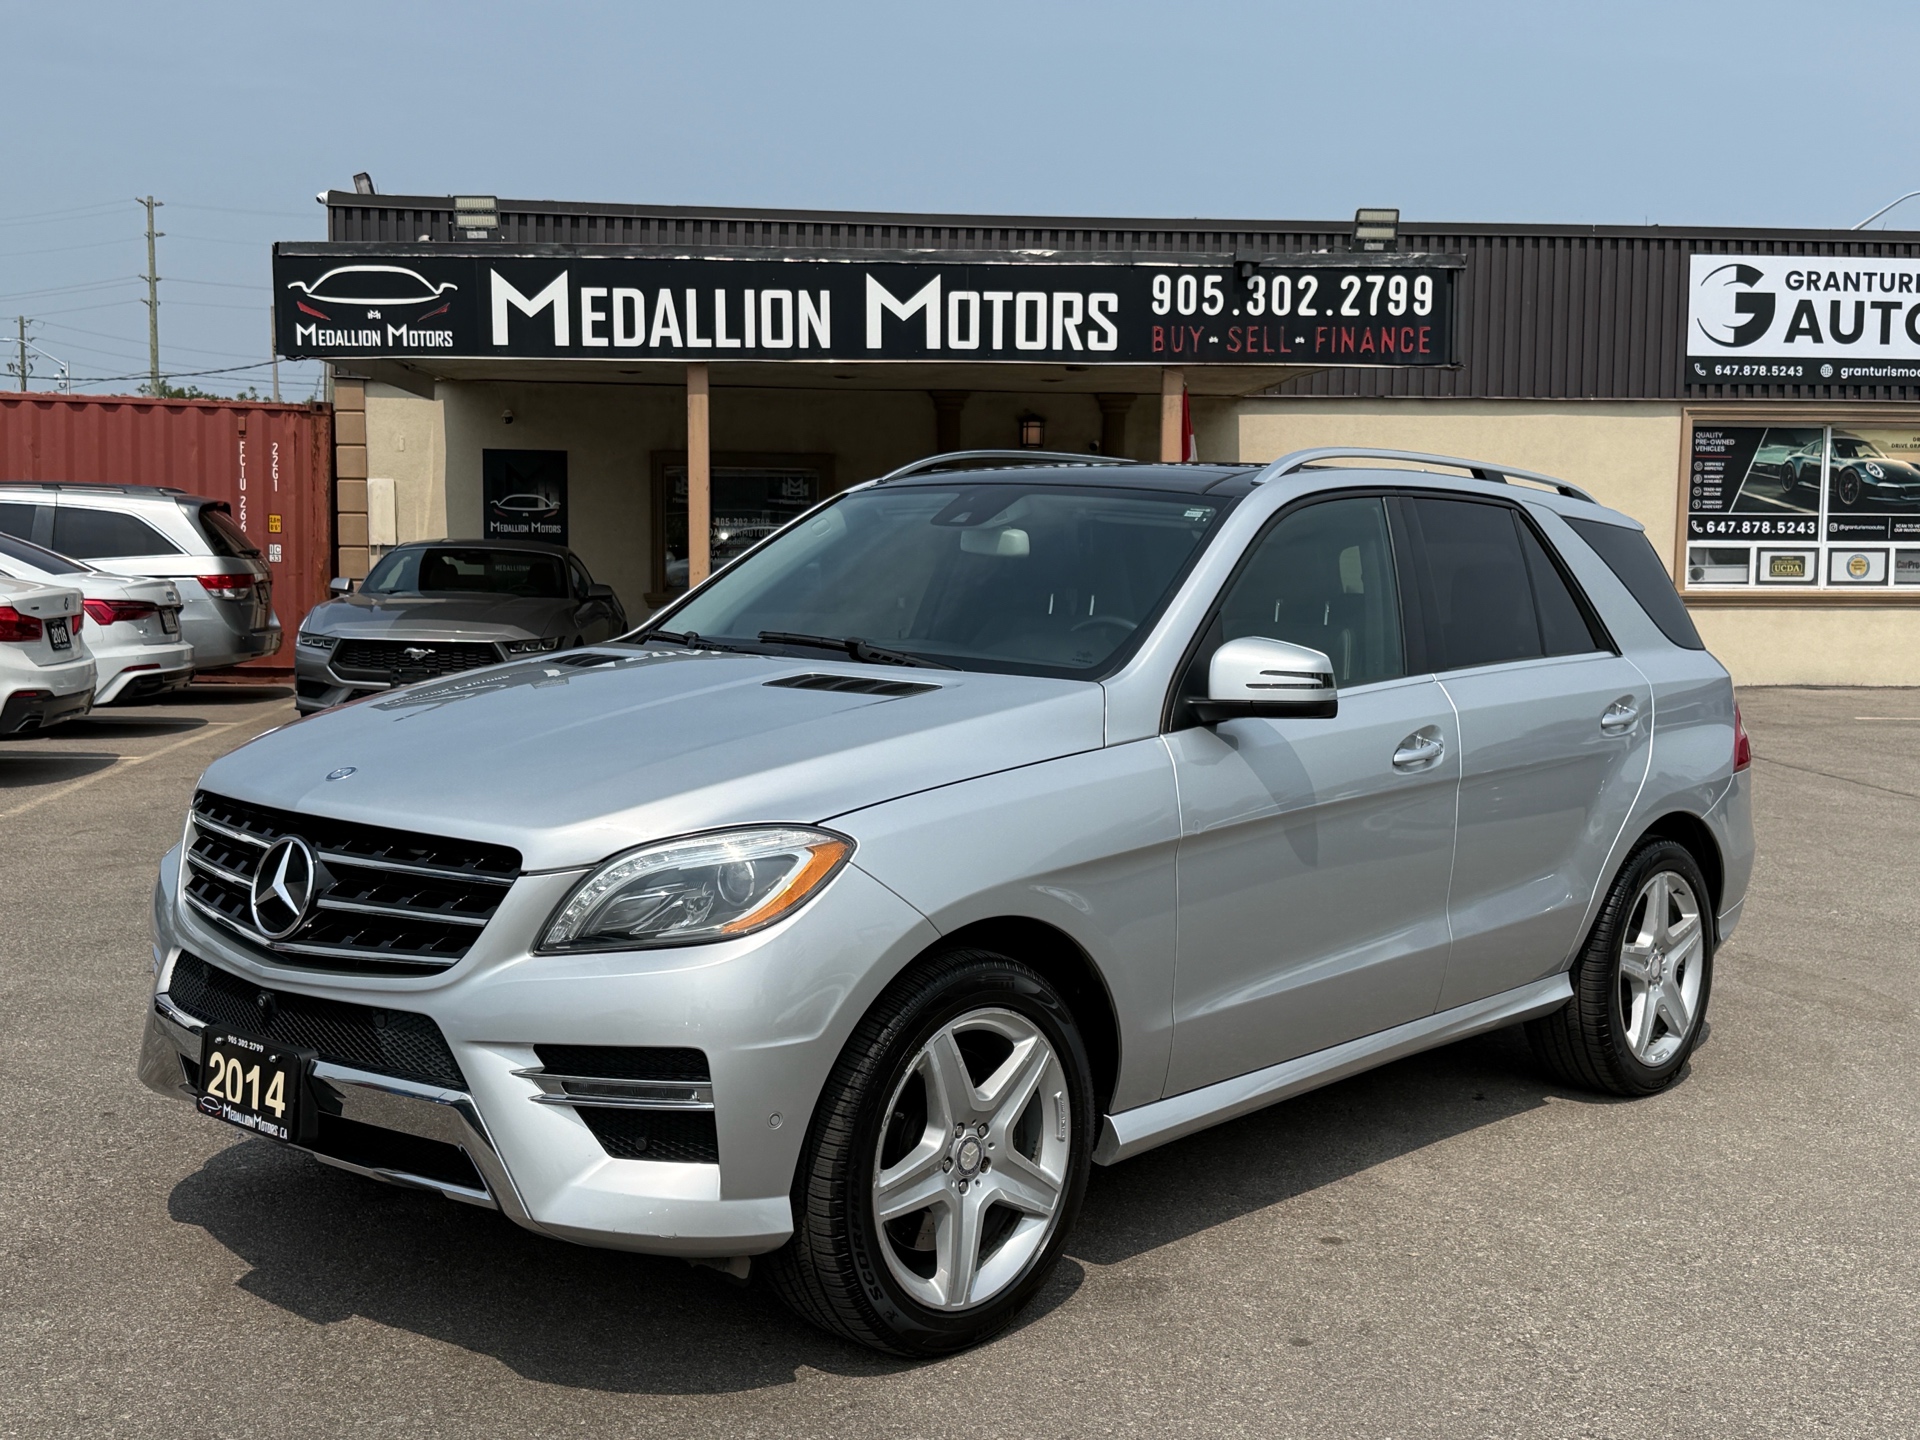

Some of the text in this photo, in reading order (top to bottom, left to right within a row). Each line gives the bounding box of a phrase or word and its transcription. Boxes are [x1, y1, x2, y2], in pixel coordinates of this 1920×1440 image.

[1151, 273, 1433, 317] 905.302.2799
[490, 267, 1119, 352] MEDALLION MOTORS
[295, 322, 453, 347] MEDALLION MOTORS
[1152, 324, 1431, 354] BUY SELL FINANCE
[1714, 364, 1803, 377] 647.878.5243
[1695, 431, 1723, 439] QUALITY
[239, 441, 247, 491] FCIU
[490, 520, 562, 534] MEDALLION MOTORS
[1706, 520, 1816, 534] 647.878.5243
[1774, 564, 1800, 573] UCDA
[51, 626, 68, 644] 2018
[207, 1051, 286, 1119] 2014
